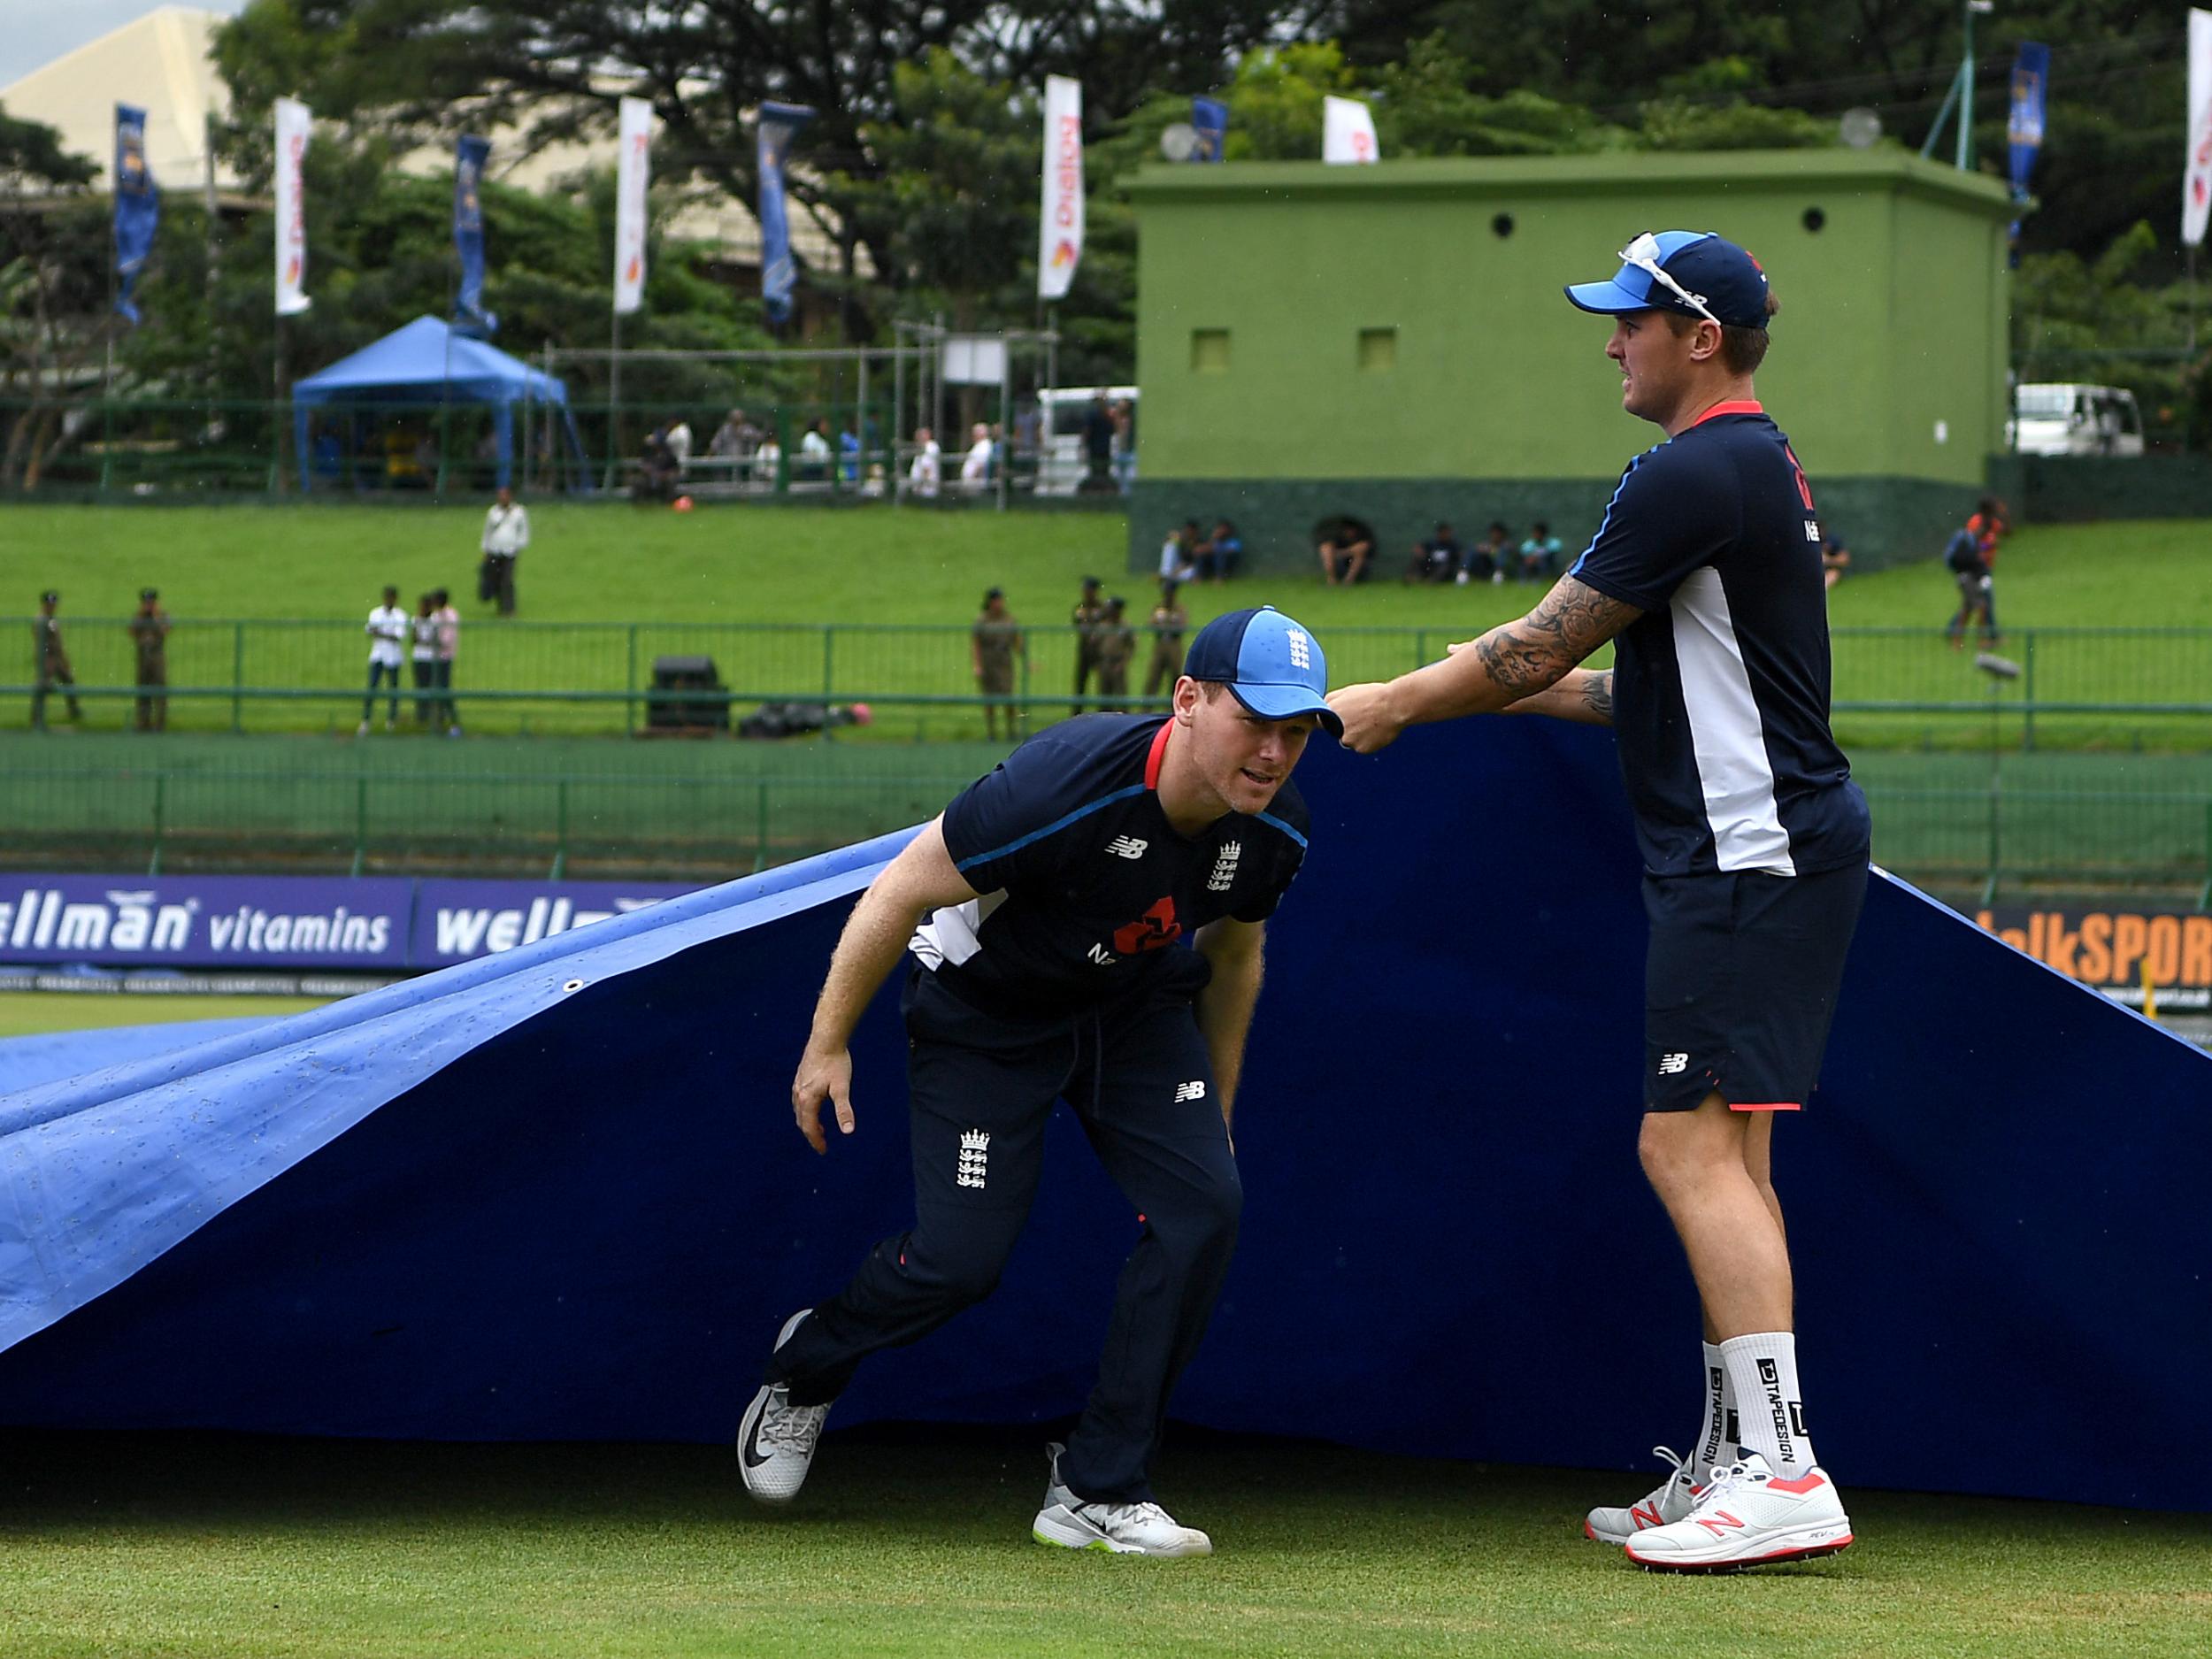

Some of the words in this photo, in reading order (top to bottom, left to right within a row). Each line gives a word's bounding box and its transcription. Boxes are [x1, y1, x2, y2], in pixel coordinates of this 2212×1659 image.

[210, 905, 390, 953] vitamins
[1701, 1391, 1724, 1465] TAPEDESIGN
[1766, 1385, 1795, 1463] TAPEDESIGN
